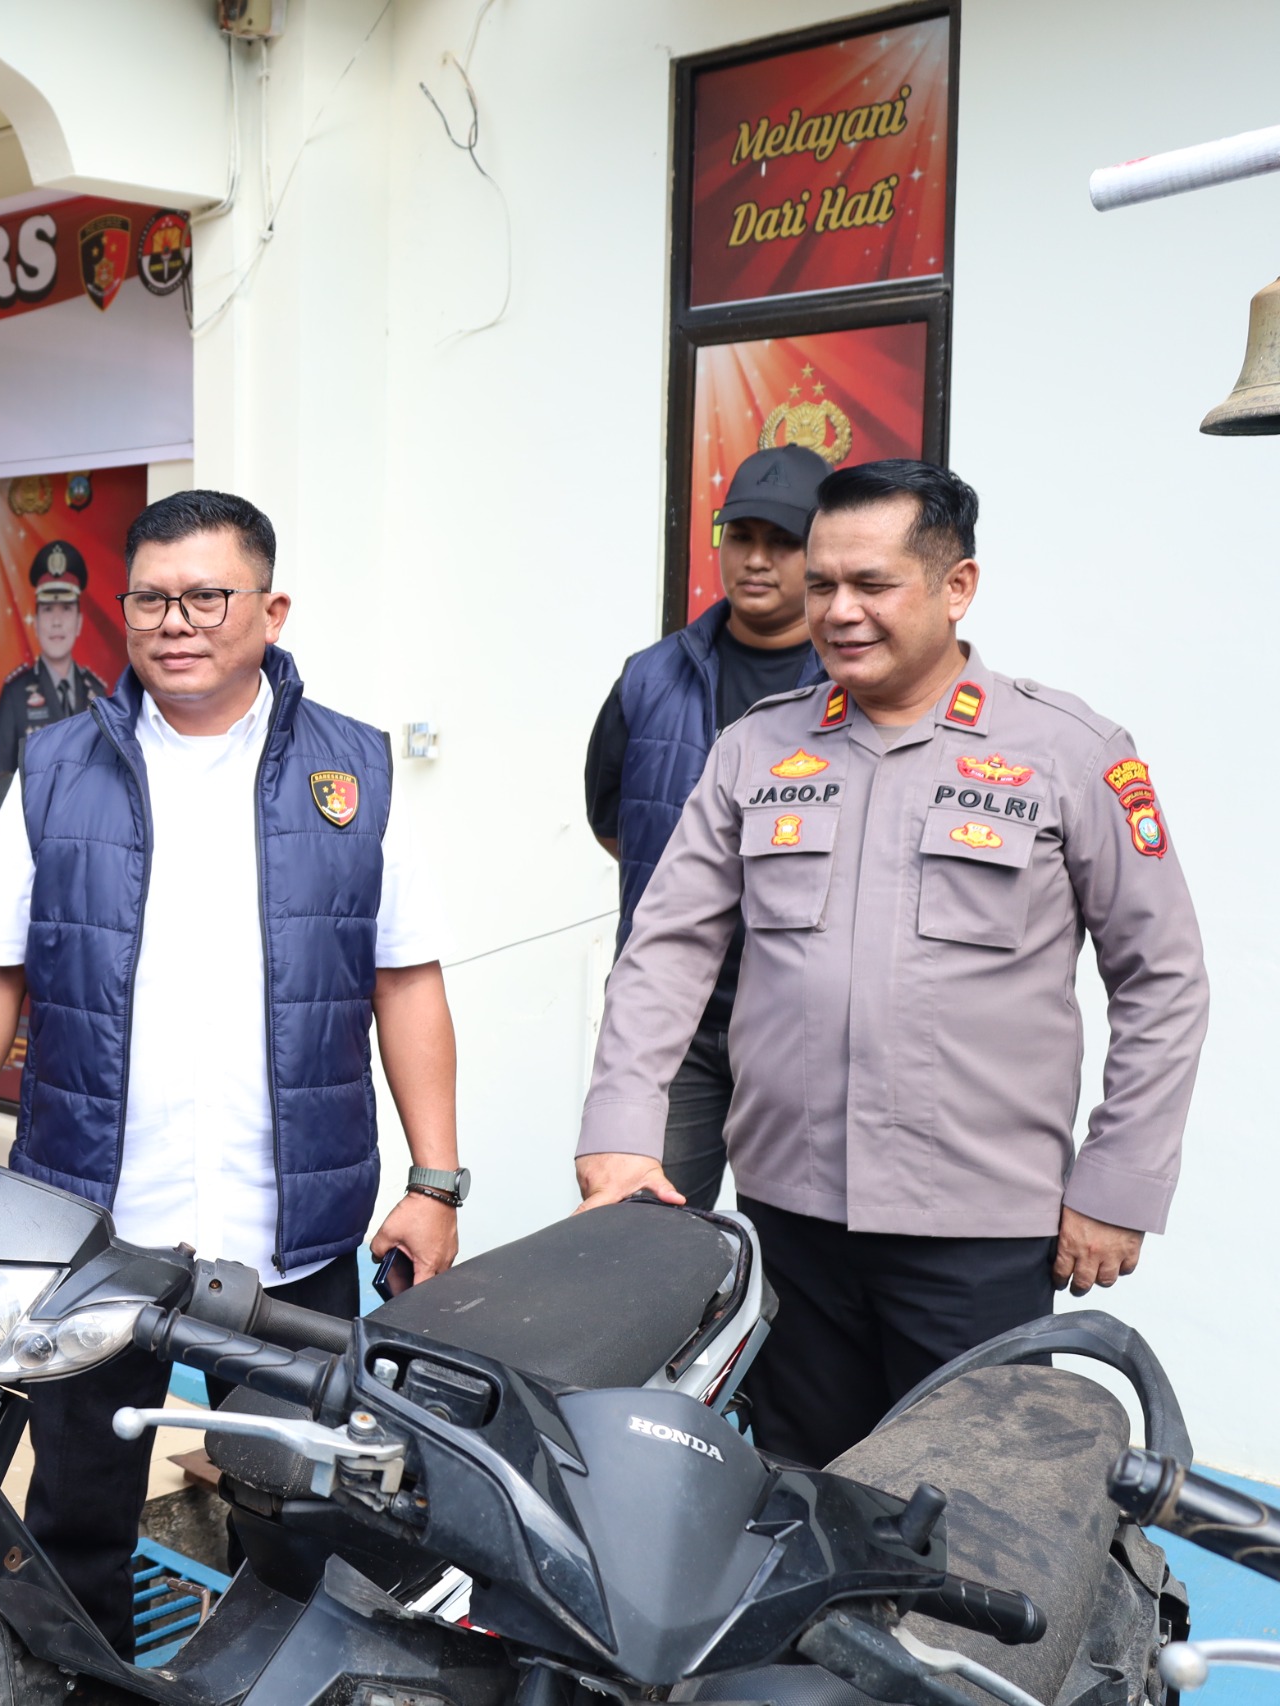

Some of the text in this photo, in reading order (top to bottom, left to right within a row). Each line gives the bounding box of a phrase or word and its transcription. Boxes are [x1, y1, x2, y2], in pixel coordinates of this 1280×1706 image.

[730, 85, 912, 165] Melayani
[728, 175, 900, 248] Dari Hati
[749, 783, 840, 805] JAGO.P
[933, 784, 1039, 822] POLRI
[628, 1416, 725, 1463] HONDA
